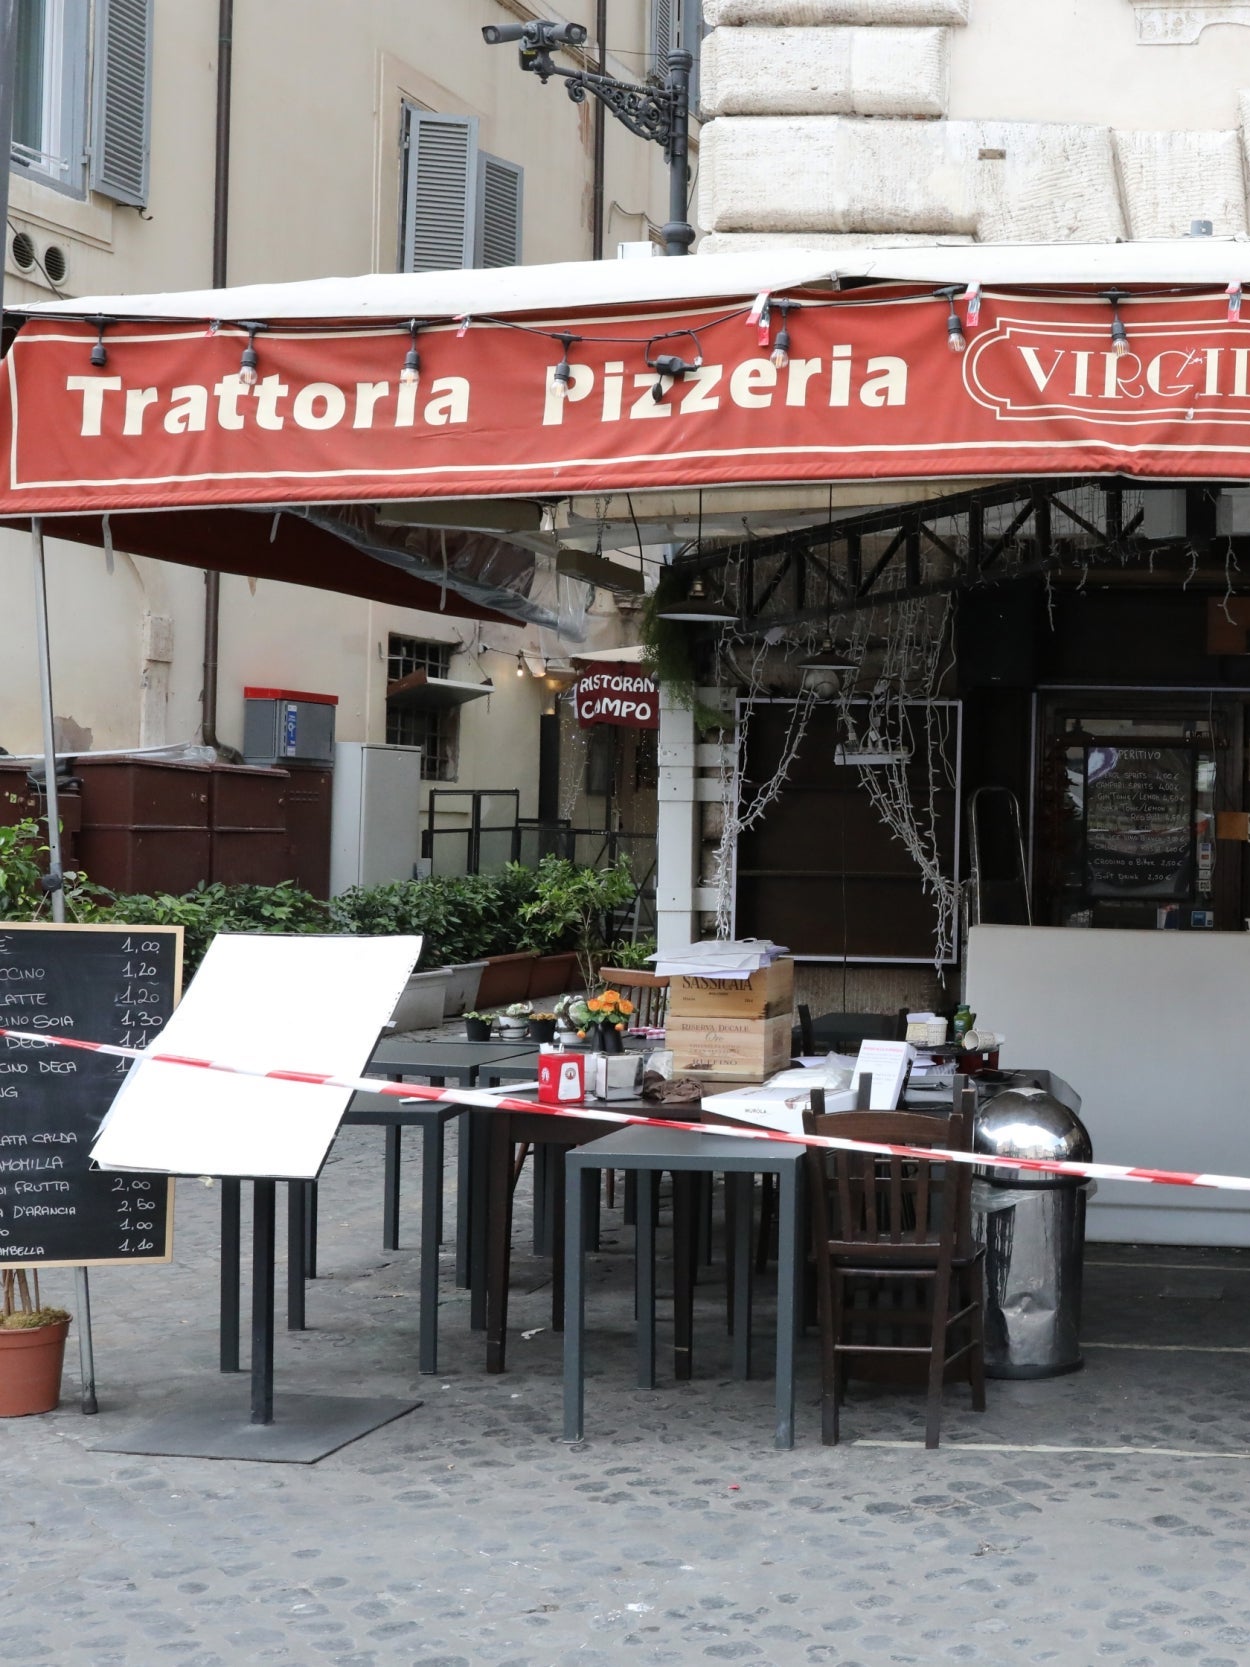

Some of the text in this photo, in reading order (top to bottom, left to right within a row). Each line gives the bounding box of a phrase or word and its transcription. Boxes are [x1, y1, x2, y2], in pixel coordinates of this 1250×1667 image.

[66, 344, 909, 436] Trattoria Pizzeria
[580, 674, 657, 692] RISTORAN
[1118, 749, 1160, 760] PERITIVO
[121, 961, 157, 978] 1,20
[682, 976, 753, 991] SASSICAIA
[119, 985, 160, 1006] 1,20
[32, 1015, 74, 1028] SOIA
[121, 1010, 163, 1027] 1,30
[681, 1023, 750, 1032] RISERVA DUCALE
[38, 1061, 77, 1073] DECA
[32, 1132, 77, 1144] CALDA
[15, 1181, 69, 1195] FRUTTA
[111, 1177, 151, 1192] 2,00
[13, 1205, 76, 1219] D'ARANCIA
